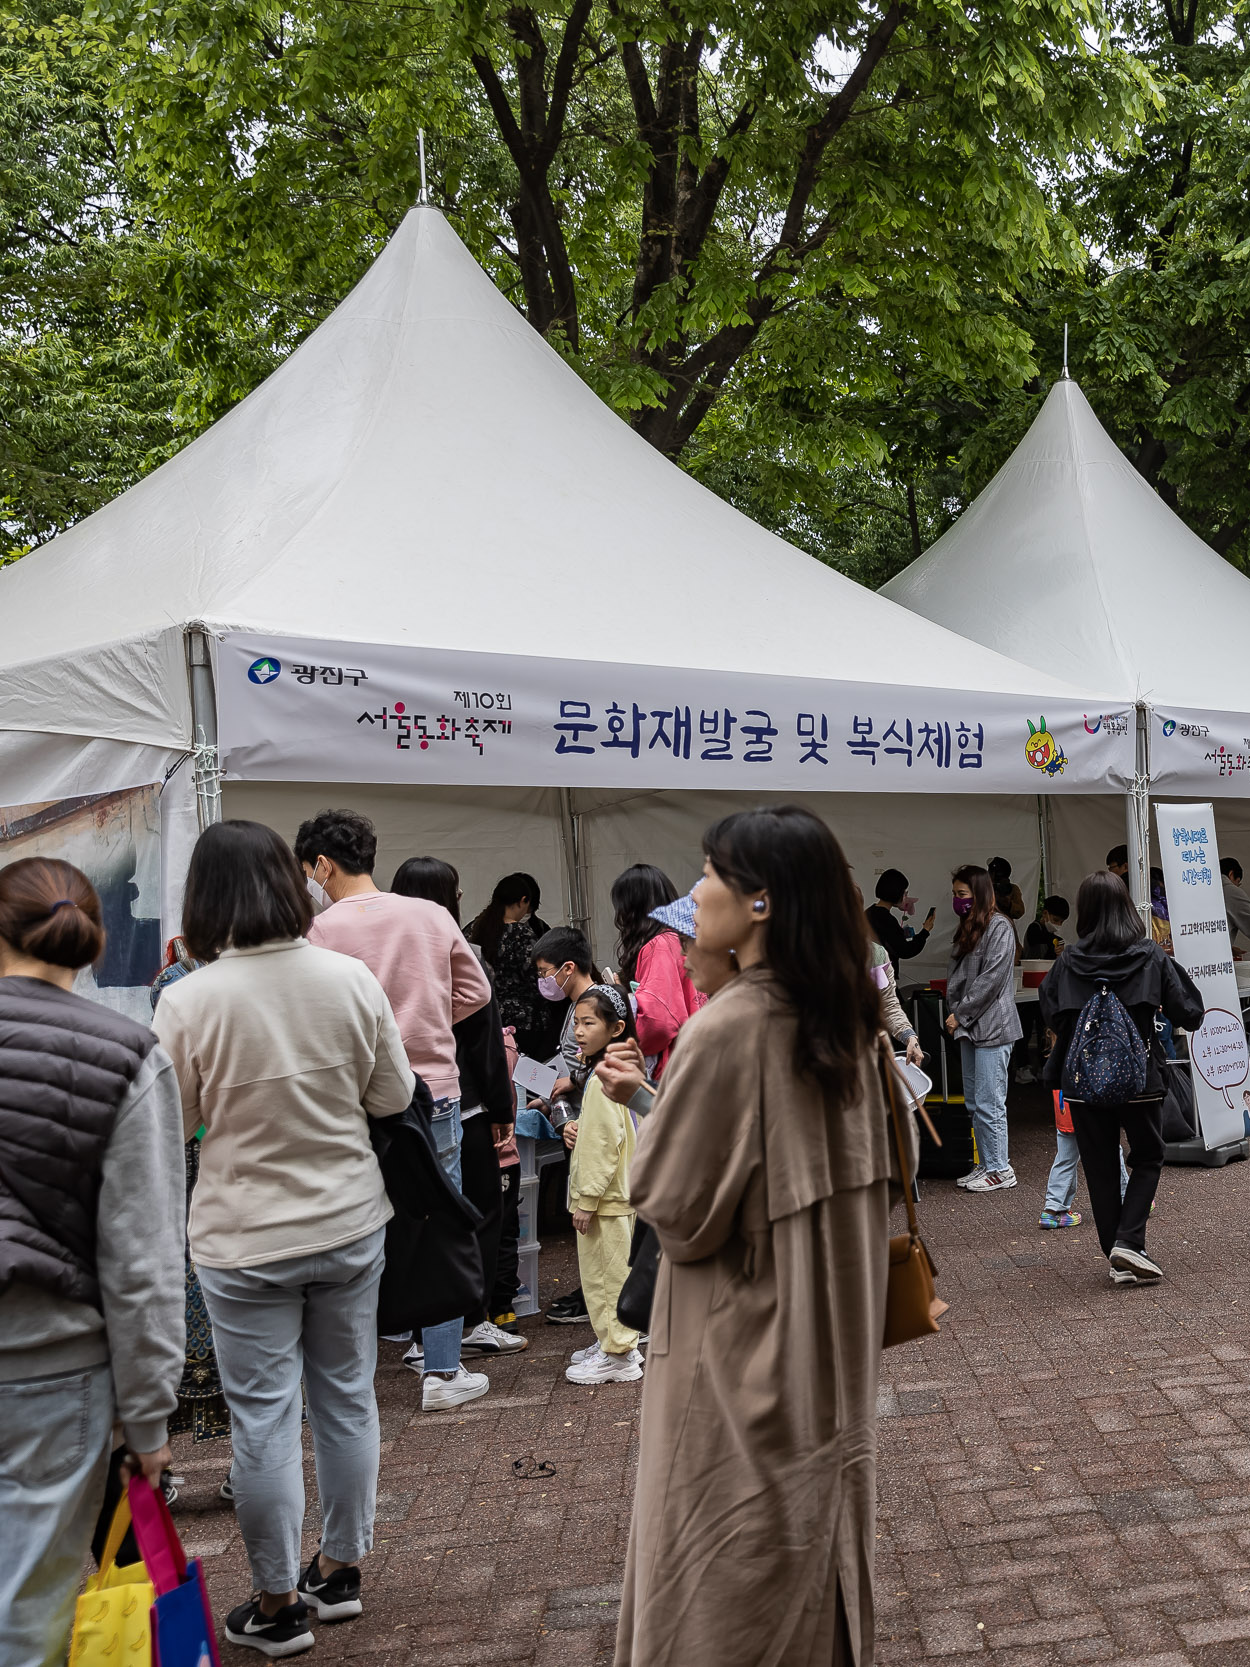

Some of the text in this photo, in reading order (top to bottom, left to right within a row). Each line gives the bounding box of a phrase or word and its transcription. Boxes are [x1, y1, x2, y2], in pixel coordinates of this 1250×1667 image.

[290, 663, 369, 687] 광진구
[453, 690, 512, 711] 제10회
[356, 701, 512, 756] 서울동화축제
[553, 700, 985, 769] 문화재발굴 및 복식체험
[1179, 723, 1210, 737] 광진구
[1180, 920, 1227, 936] 고고학자직업체험
[1187, 961, 1233, 980] 삼국시대복식체험
